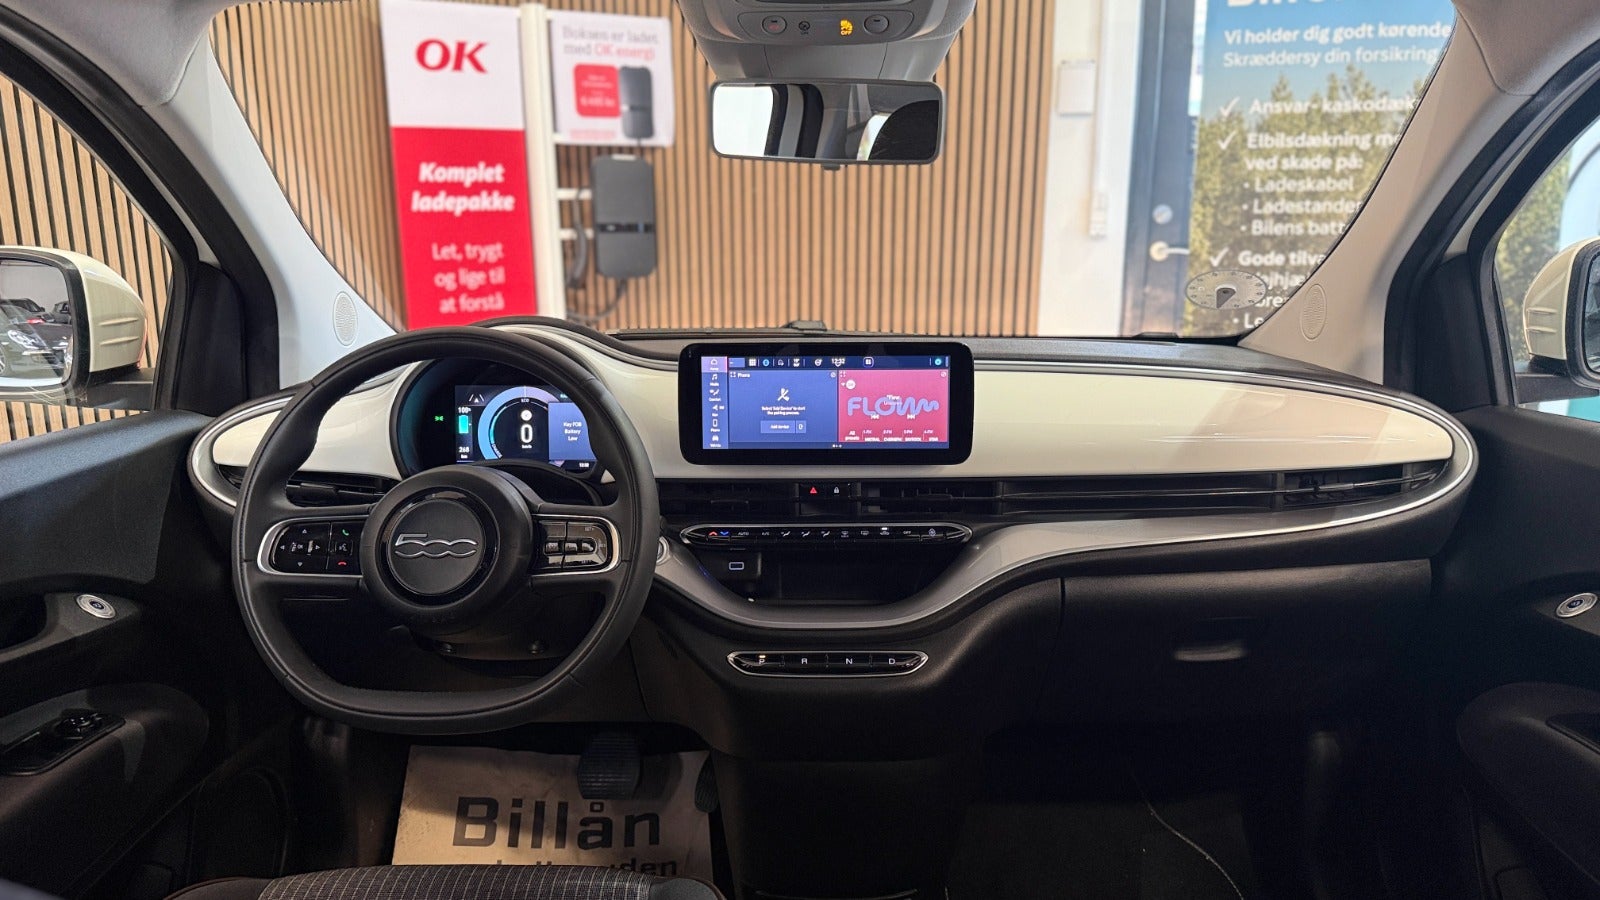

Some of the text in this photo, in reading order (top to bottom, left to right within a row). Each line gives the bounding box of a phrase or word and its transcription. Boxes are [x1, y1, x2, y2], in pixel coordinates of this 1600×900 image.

[1223, 20, 1451, 45] Vi holder dig godt kørende
[415, 38, 488, 74] OK
[563, 44, 592, 56] med
[594, 43, 615, 57] OK
[1223, 45, 1438, 68] Skræddersy din forsikring
[1249, 99, 1319, 115] Ansvar-
[1246, 131, 1372, 151] Elbilsdækning
[1245, 155, 1278, 171] ved
[1281, 153, 1333, 170] skade
[418, 161, 505, 188] Komplet
[1254, 177, 1354, 193] Ladeskabel
[410, 189, 516, 217] ladepakke
[1250, 219, 1304, 236] Bilens
[431, 241, 505, 264] Let, trygt
[1237, 250, 1287, 267] Gode
[433, 265, 506, 292] og lige til
[439, 291, 505, 314] at forstå
[521, 424, 533, 443] 0
[395, 533, 478, 558] 500
[452, 796, 660, 850] Billån
